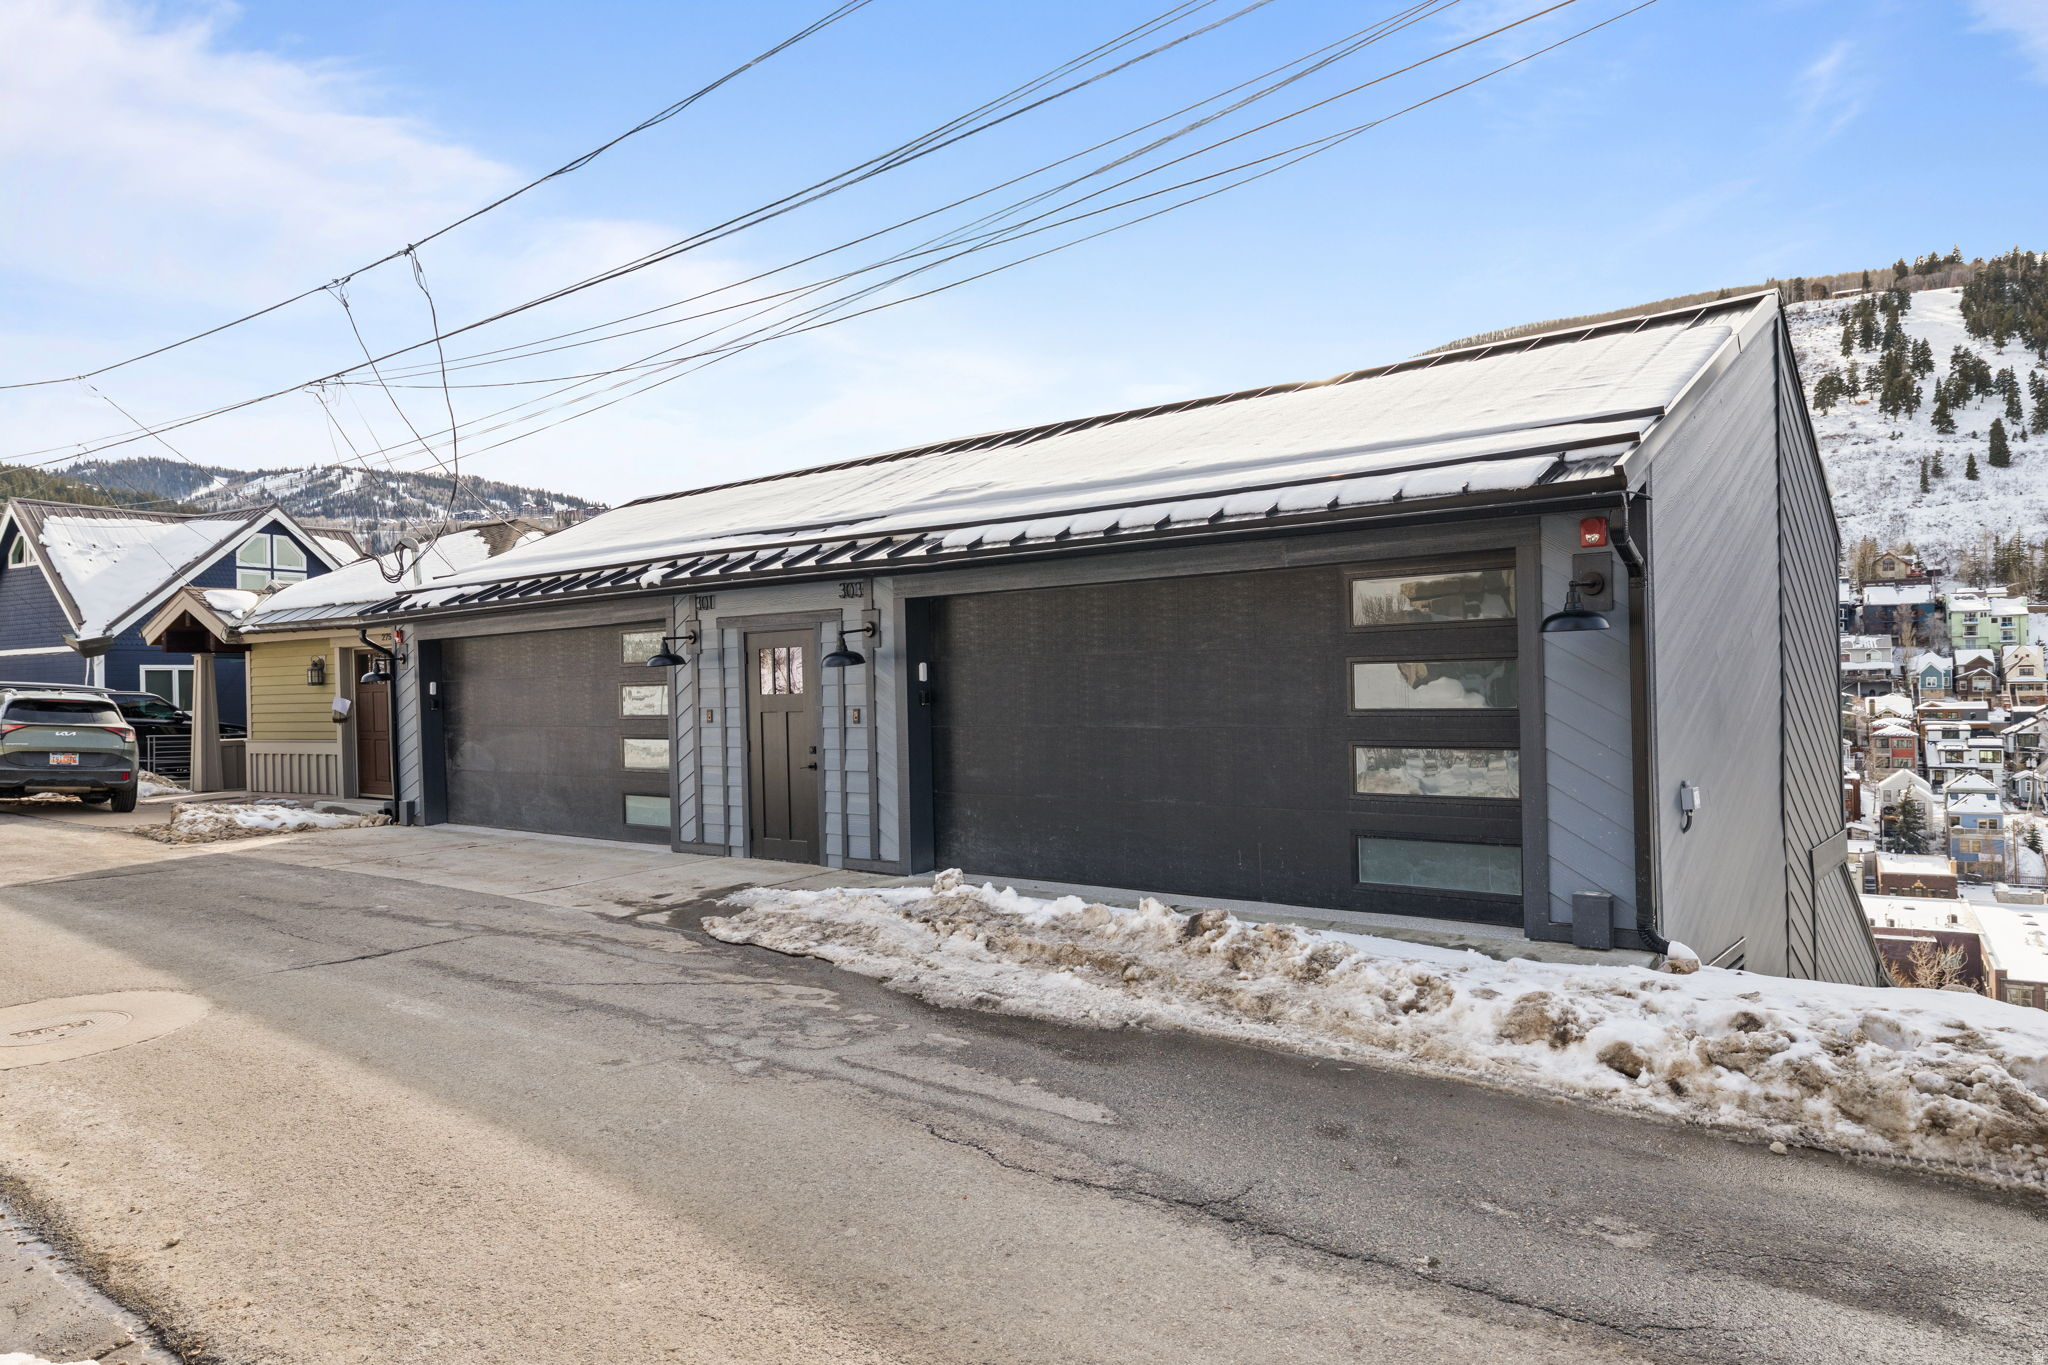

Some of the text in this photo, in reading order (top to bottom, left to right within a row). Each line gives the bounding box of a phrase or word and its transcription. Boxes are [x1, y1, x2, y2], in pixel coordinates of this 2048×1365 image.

[838, 582, 864, 598] 303
[695, 595, 715, 610] 301
[381, 633, 392, 641] 275
